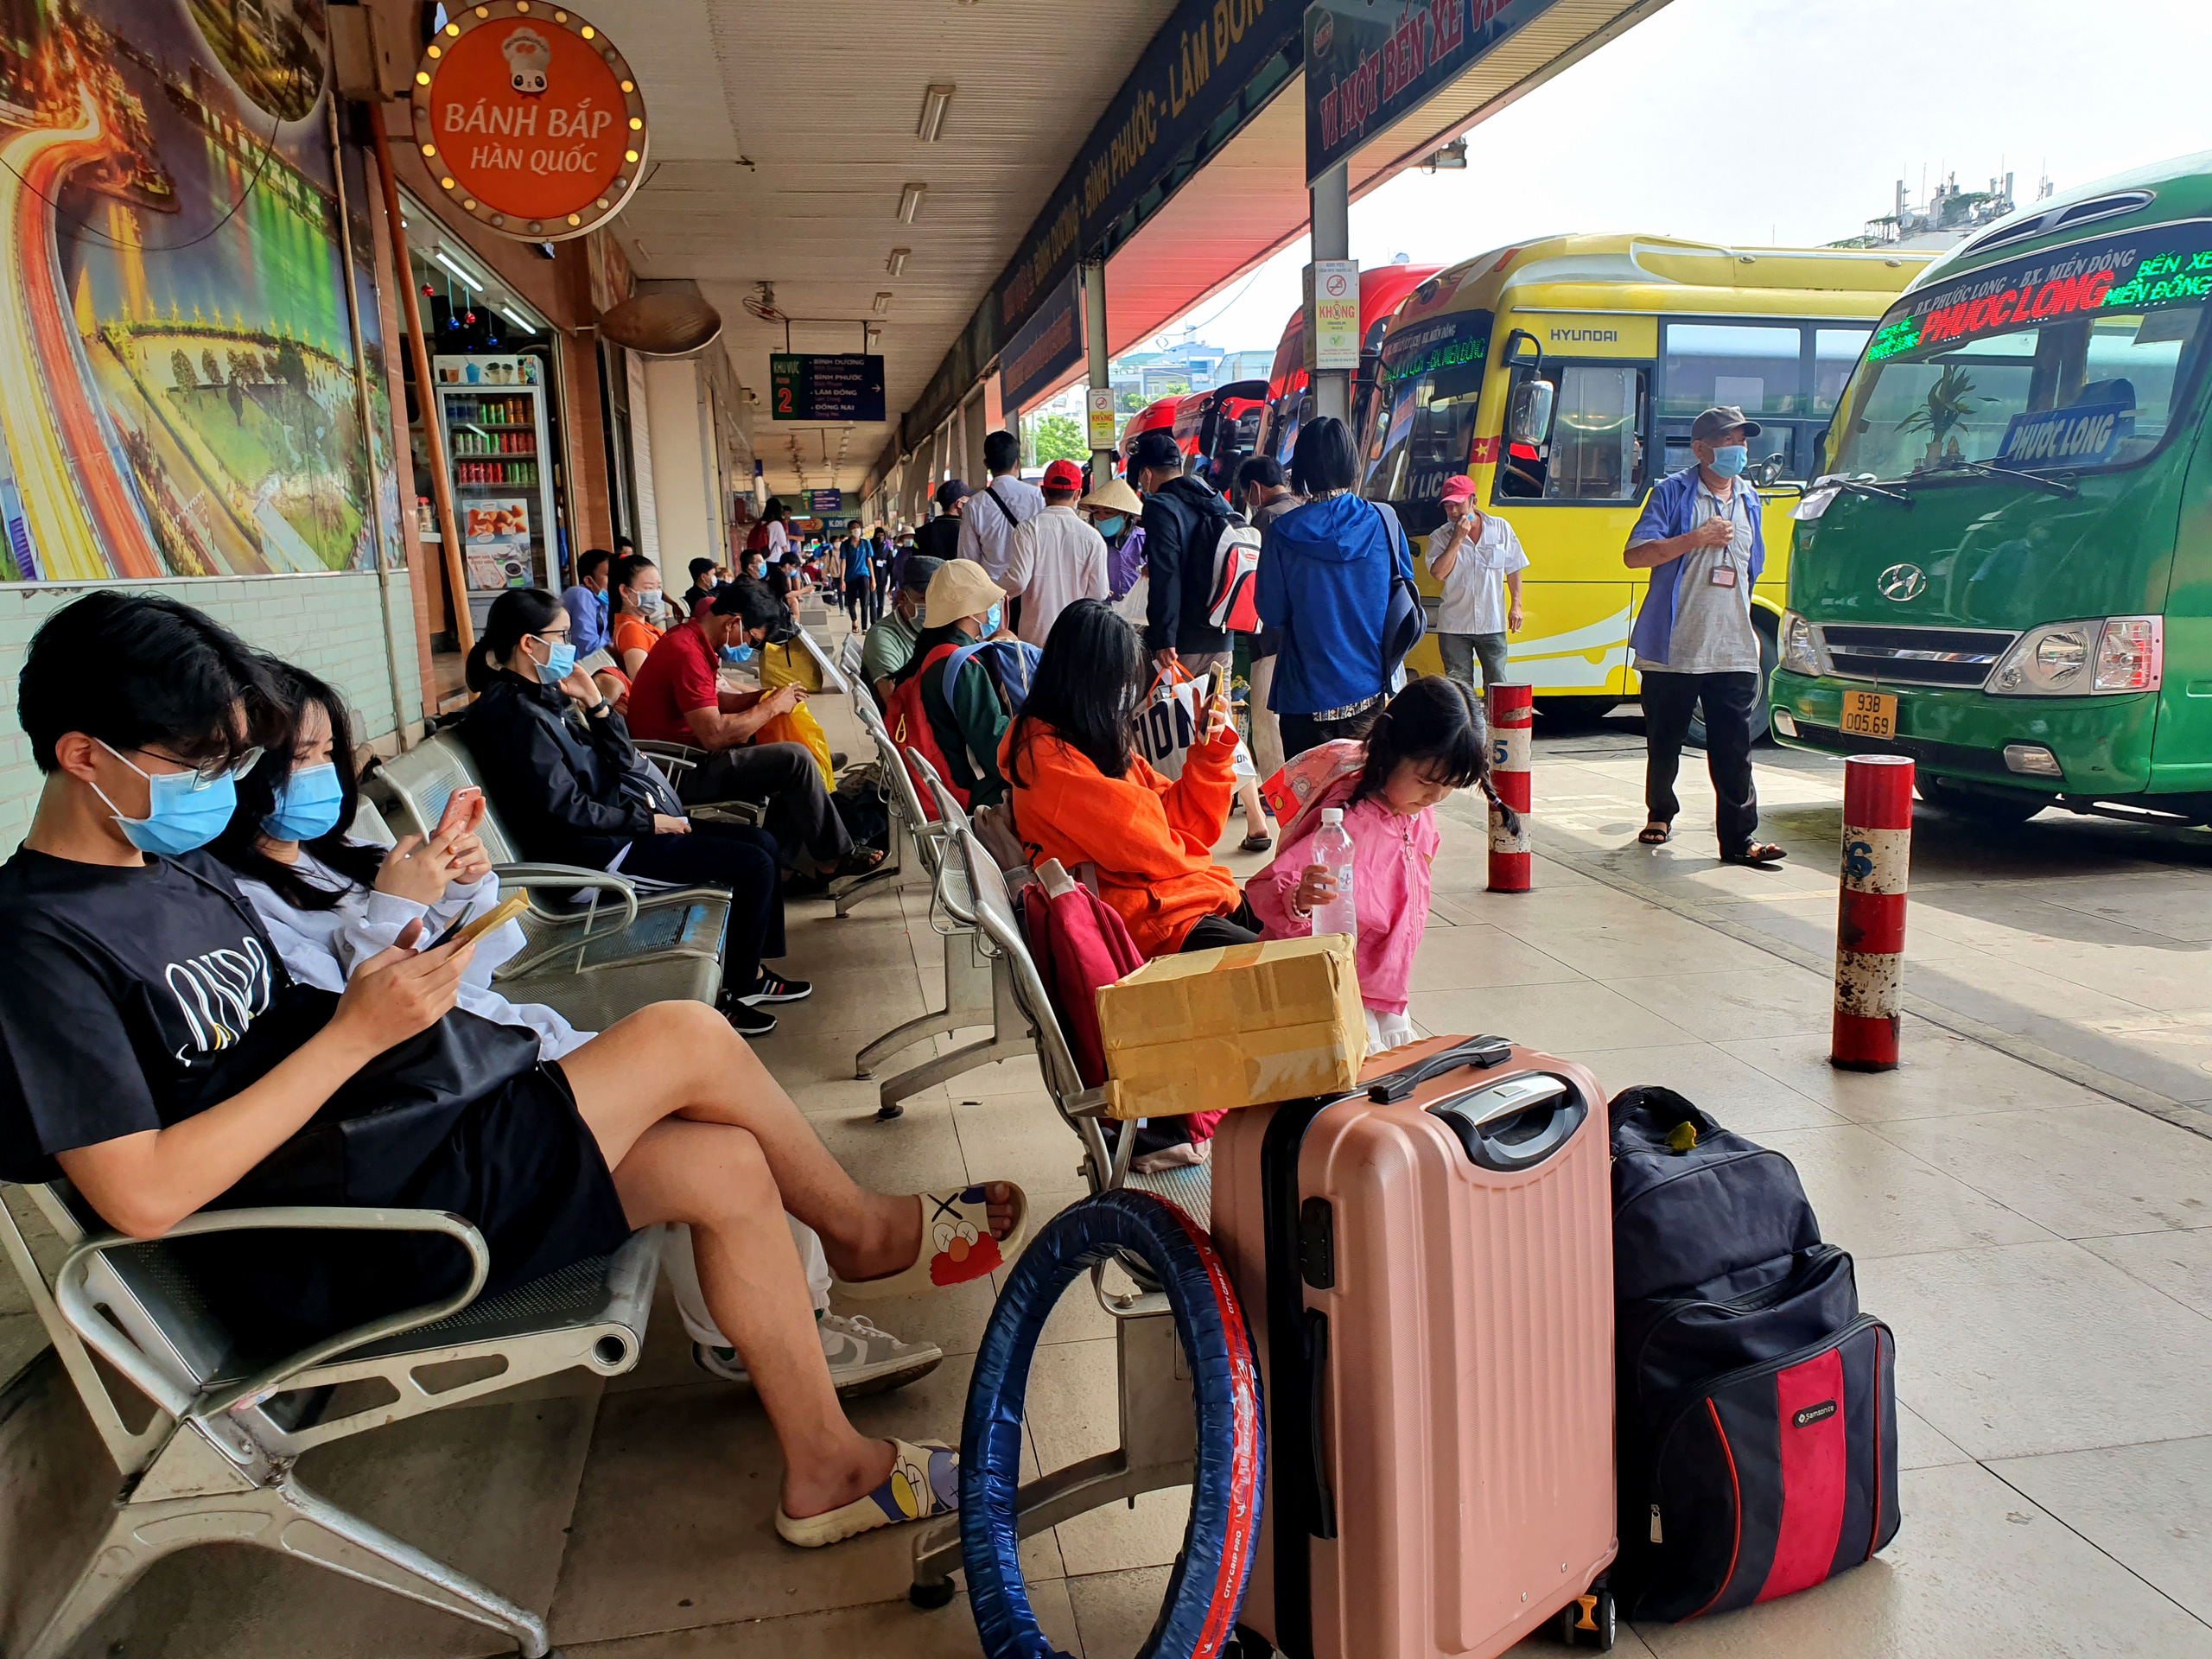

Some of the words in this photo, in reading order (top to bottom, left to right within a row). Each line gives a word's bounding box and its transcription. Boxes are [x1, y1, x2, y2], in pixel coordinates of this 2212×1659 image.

[1168, 29, 1211, 119] LÂM
[1340, 48, 1381, 138] MỘT
[1382, 0, 1426, 105] BẾN
[444, 98, 537, 137] BÁNH
[547, 98, 613, 139] BẮP
[470, 143, 523, 170] HÀN
[530, 143, 598, 175] QUỐC
[1970, 276, 2008, 301] LONG
[2085, 248, 2137, 276] ĐÔNG
[2136, 250, 2183, 277] BẾN
[2185, 250, 2212, 271] XE
[2009, 269, 2114, 323] LONG
[2100, 276, 2152, 308] MIỀN
[2149, 273, 2212, 300] ĐÔNG
[1319, 300, 1355, 321] KHÔNG
[1550, 328, 1618, 342] HYUNDAI
[779, 387, 792, 413] 2
[1091, 411, 1113, 423] KHÔNG
[2005, 412, 2066, 461] PHƯỚC
[2058, 413, 2114, 456] LONG
[1857, 694, 1881, 713] 93B
[1847, 713, 1889, 735] 005.69
[1493, 739, 1509, 765] 5
[1847, 841, 1873, 878] 6
[1804, 1405, 1834, 1422] Samsonite
[1229, 1553, 1237, 1577] GRIP
